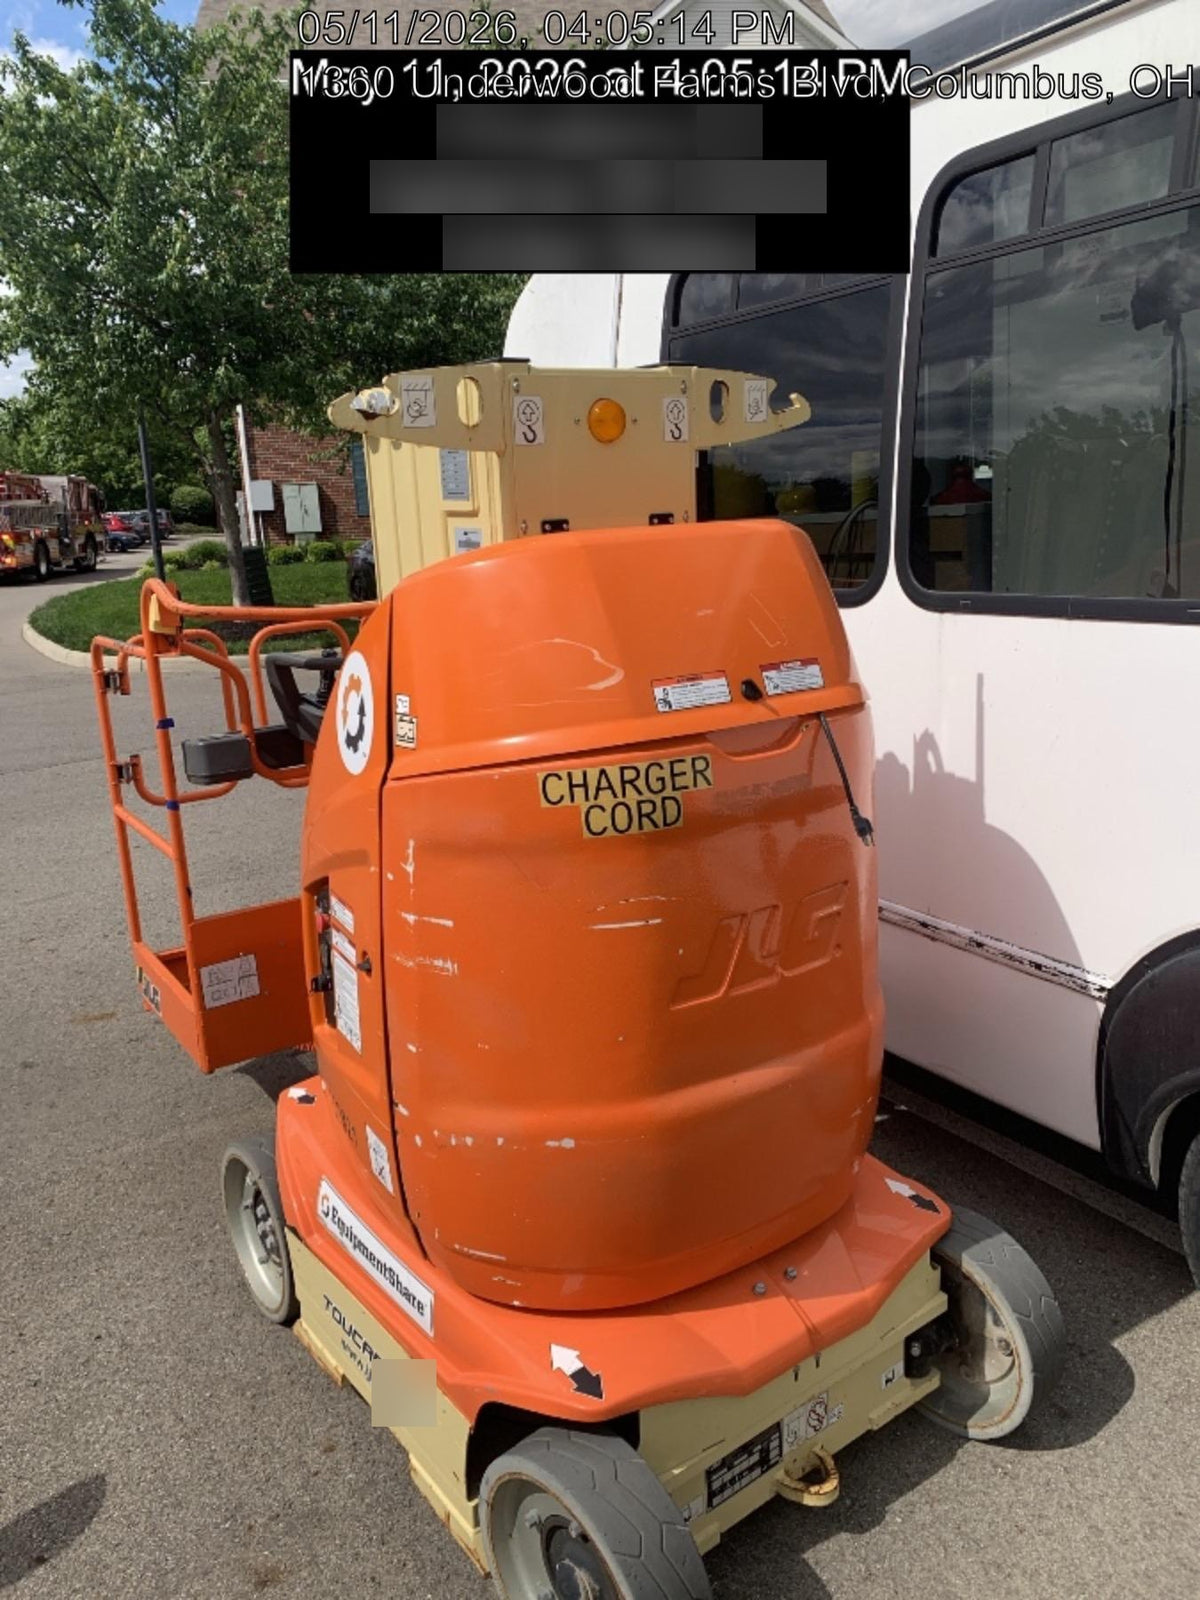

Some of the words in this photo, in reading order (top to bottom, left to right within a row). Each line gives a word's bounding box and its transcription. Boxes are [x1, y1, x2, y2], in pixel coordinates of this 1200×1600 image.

[542, 755, 712, 805] CHARGER
[584, 796, 682, 836] CORD
[331, 1204, 425, 1317] EquipmentShare
[323, 1294, 381, 1361] TOUCA
